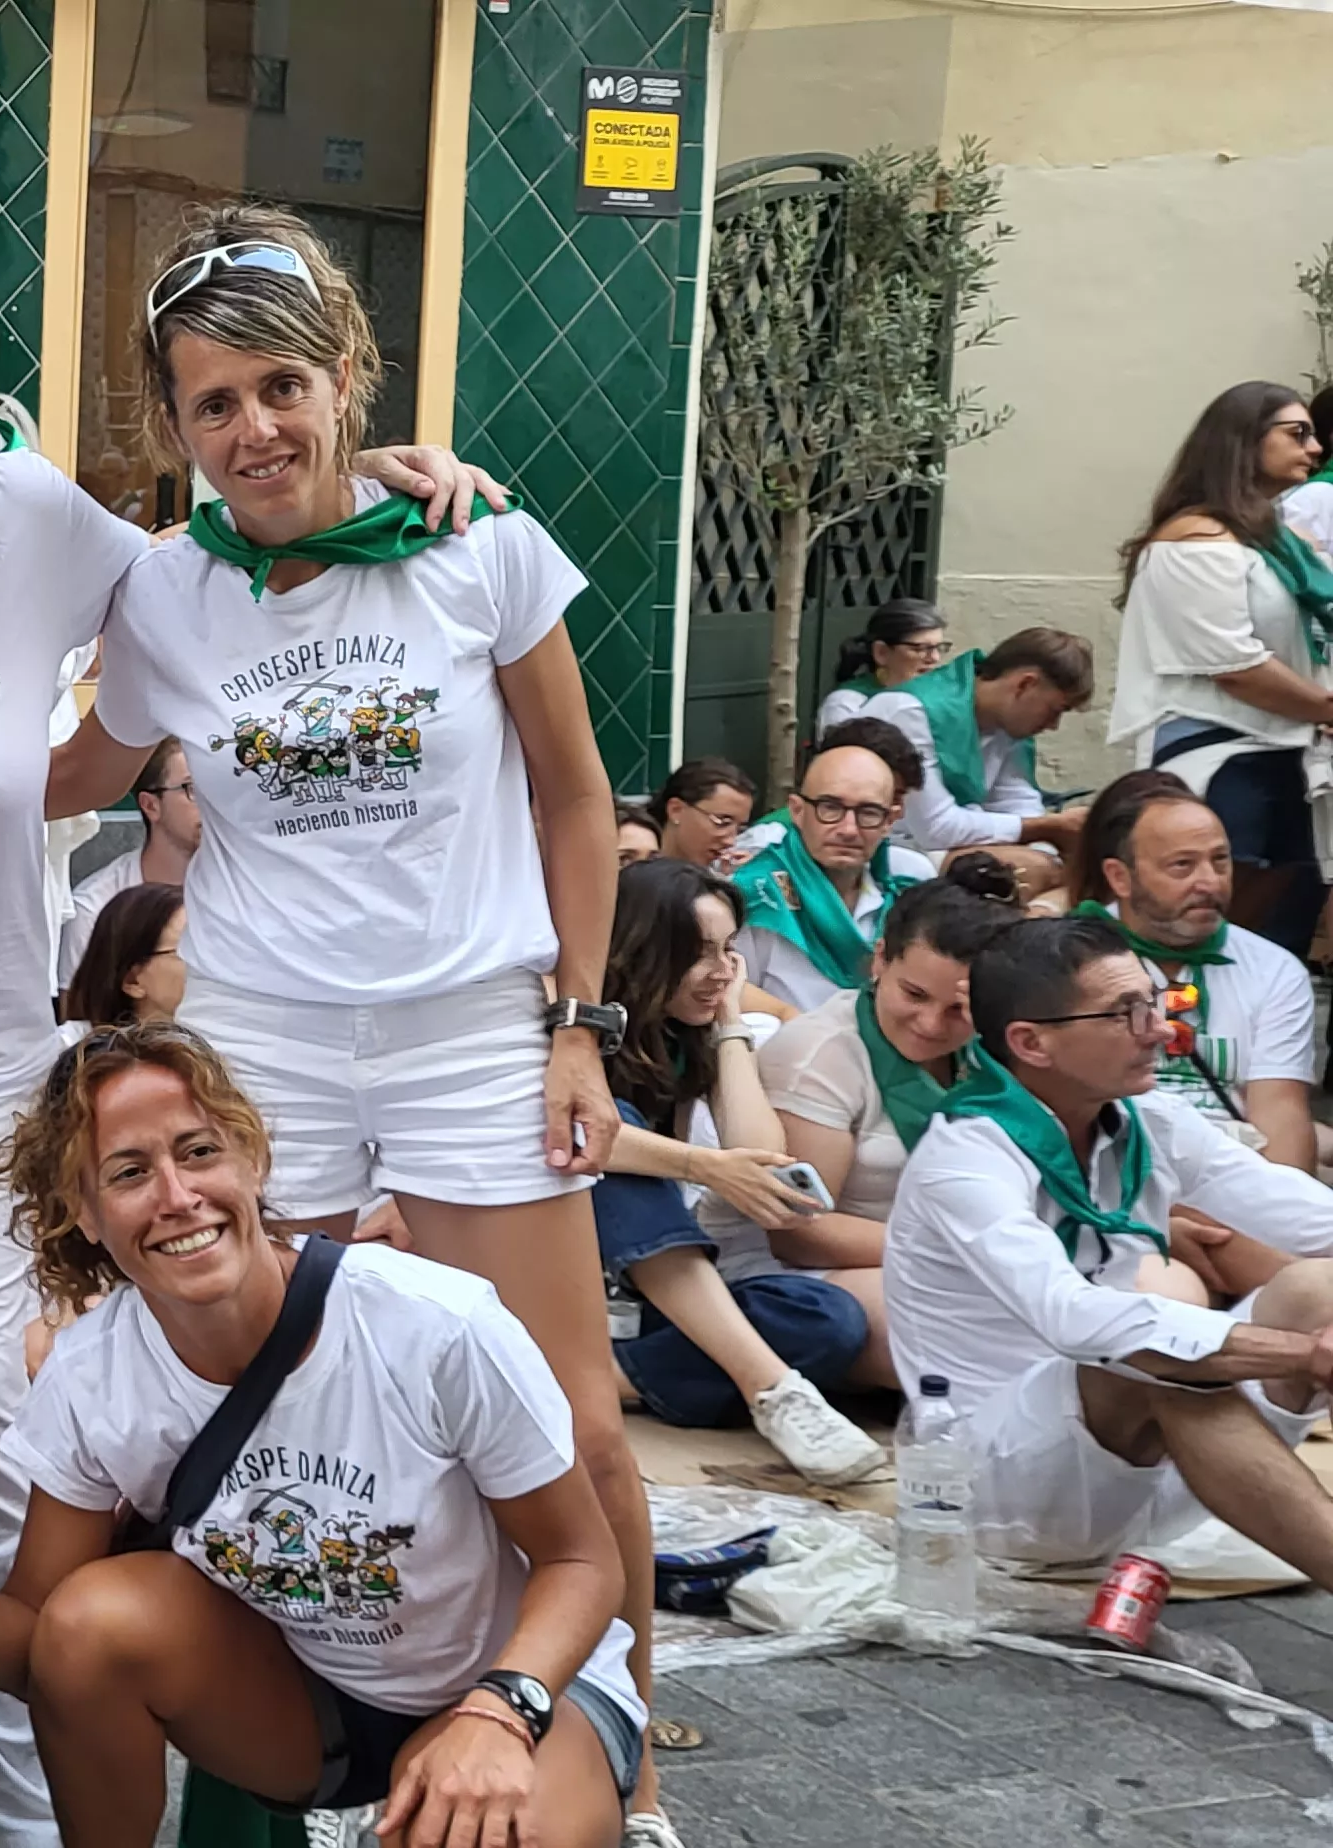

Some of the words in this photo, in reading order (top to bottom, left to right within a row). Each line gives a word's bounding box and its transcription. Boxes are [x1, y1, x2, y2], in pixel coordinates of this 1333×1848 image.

[593, 121, 671, 139] CONECTADA
[220, 641, 327, 703] CRISESPE
[335, 634, 406, 670] DANZA
[274, 809, 351, 838] Haciendo
[352, 798, 419, 826] historia
[297, 1450, 377, 1504] DANZA
[332, 1621, 405, 1647] historia
